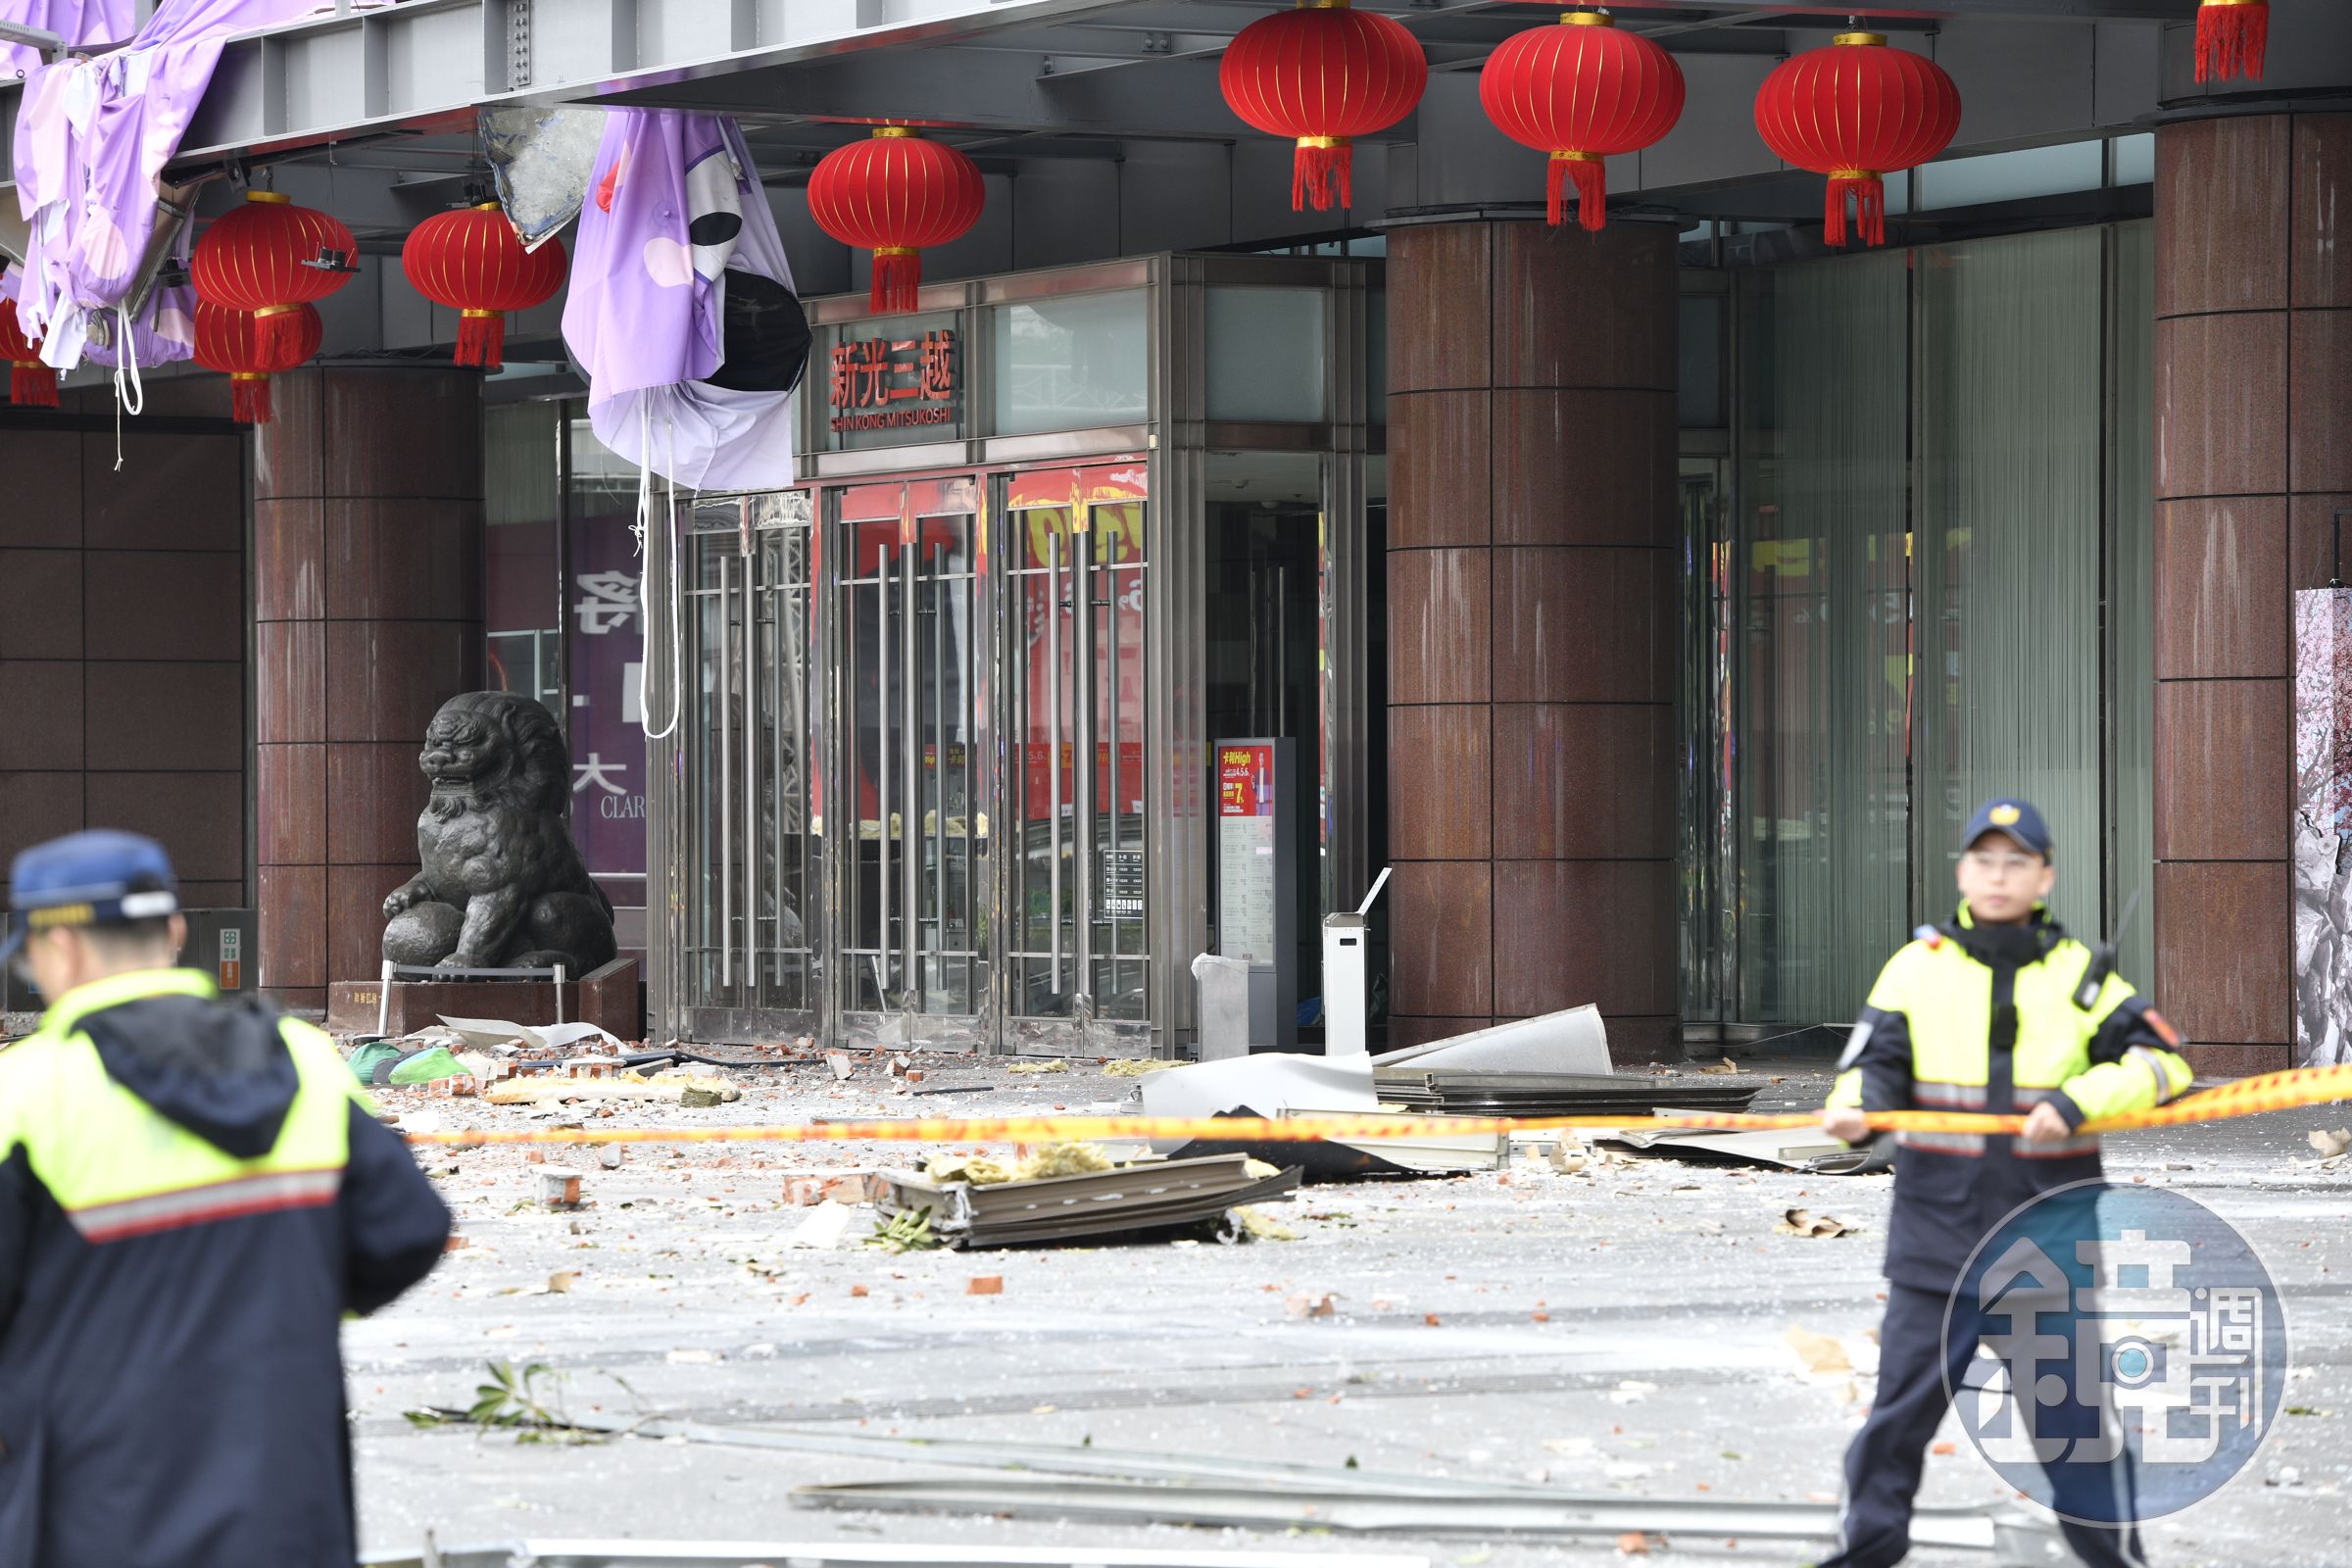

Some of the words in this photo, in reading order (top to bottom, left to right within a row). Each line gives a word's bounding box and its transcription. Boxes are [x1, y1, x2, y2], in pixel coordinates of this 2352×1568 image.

[830, 329, 952, 409] 新光三越
[830, 416, 854, 432] SHIN
[856, 413, 884, 429] KONG
[886, 407, 952, 428] MITSUKOSHI
